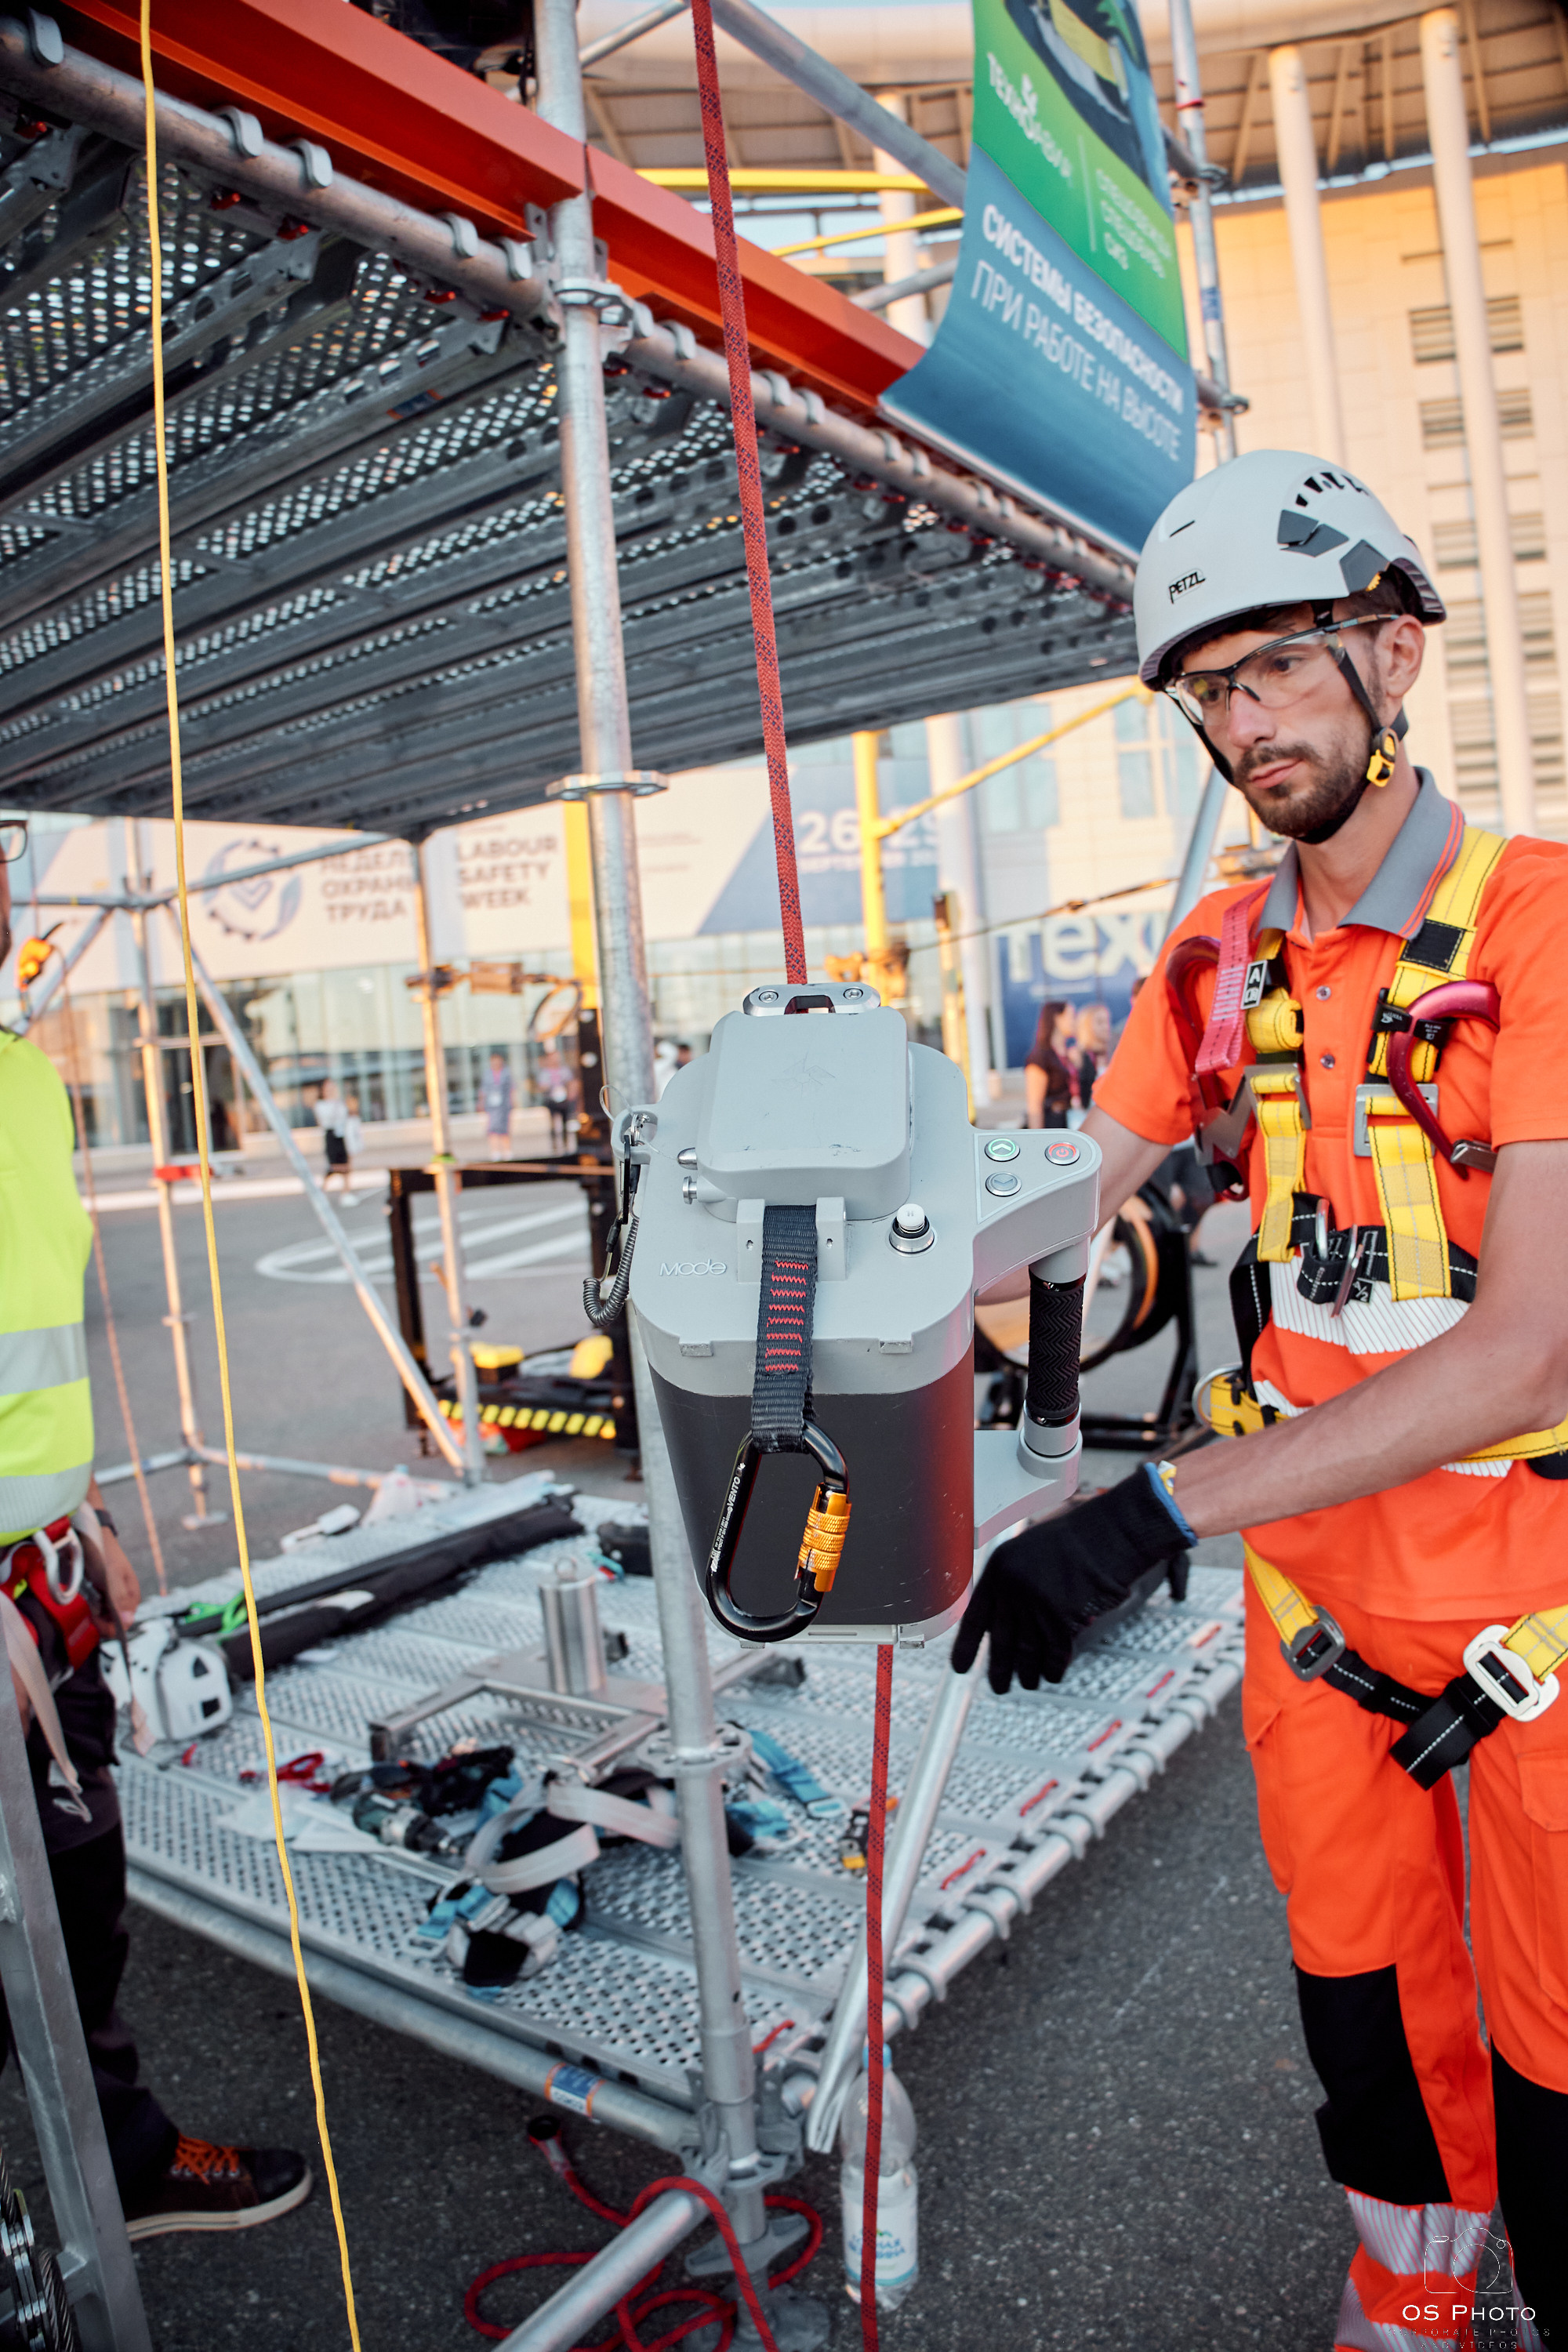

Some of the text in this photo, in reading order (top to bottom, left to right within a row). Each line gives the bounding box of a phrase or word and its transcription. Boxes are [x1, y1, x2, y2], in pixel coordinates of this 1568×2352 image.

[982, 204, 1184, 415] СИСТЕМЫ БЕЗОПАСНОСТИ
[971, 260, 1181, 461] ПРИ РАБОТЕ НА ВЫСОТЕ
[1169, 572, 1206, 604] PETZL
[456, 835, 557, 862] LABOUR
[459, 861, 550, 887] SAFETY
[461, 886, 532, 910] WEEK
[727, 1476, 741, 1506] VENTO
